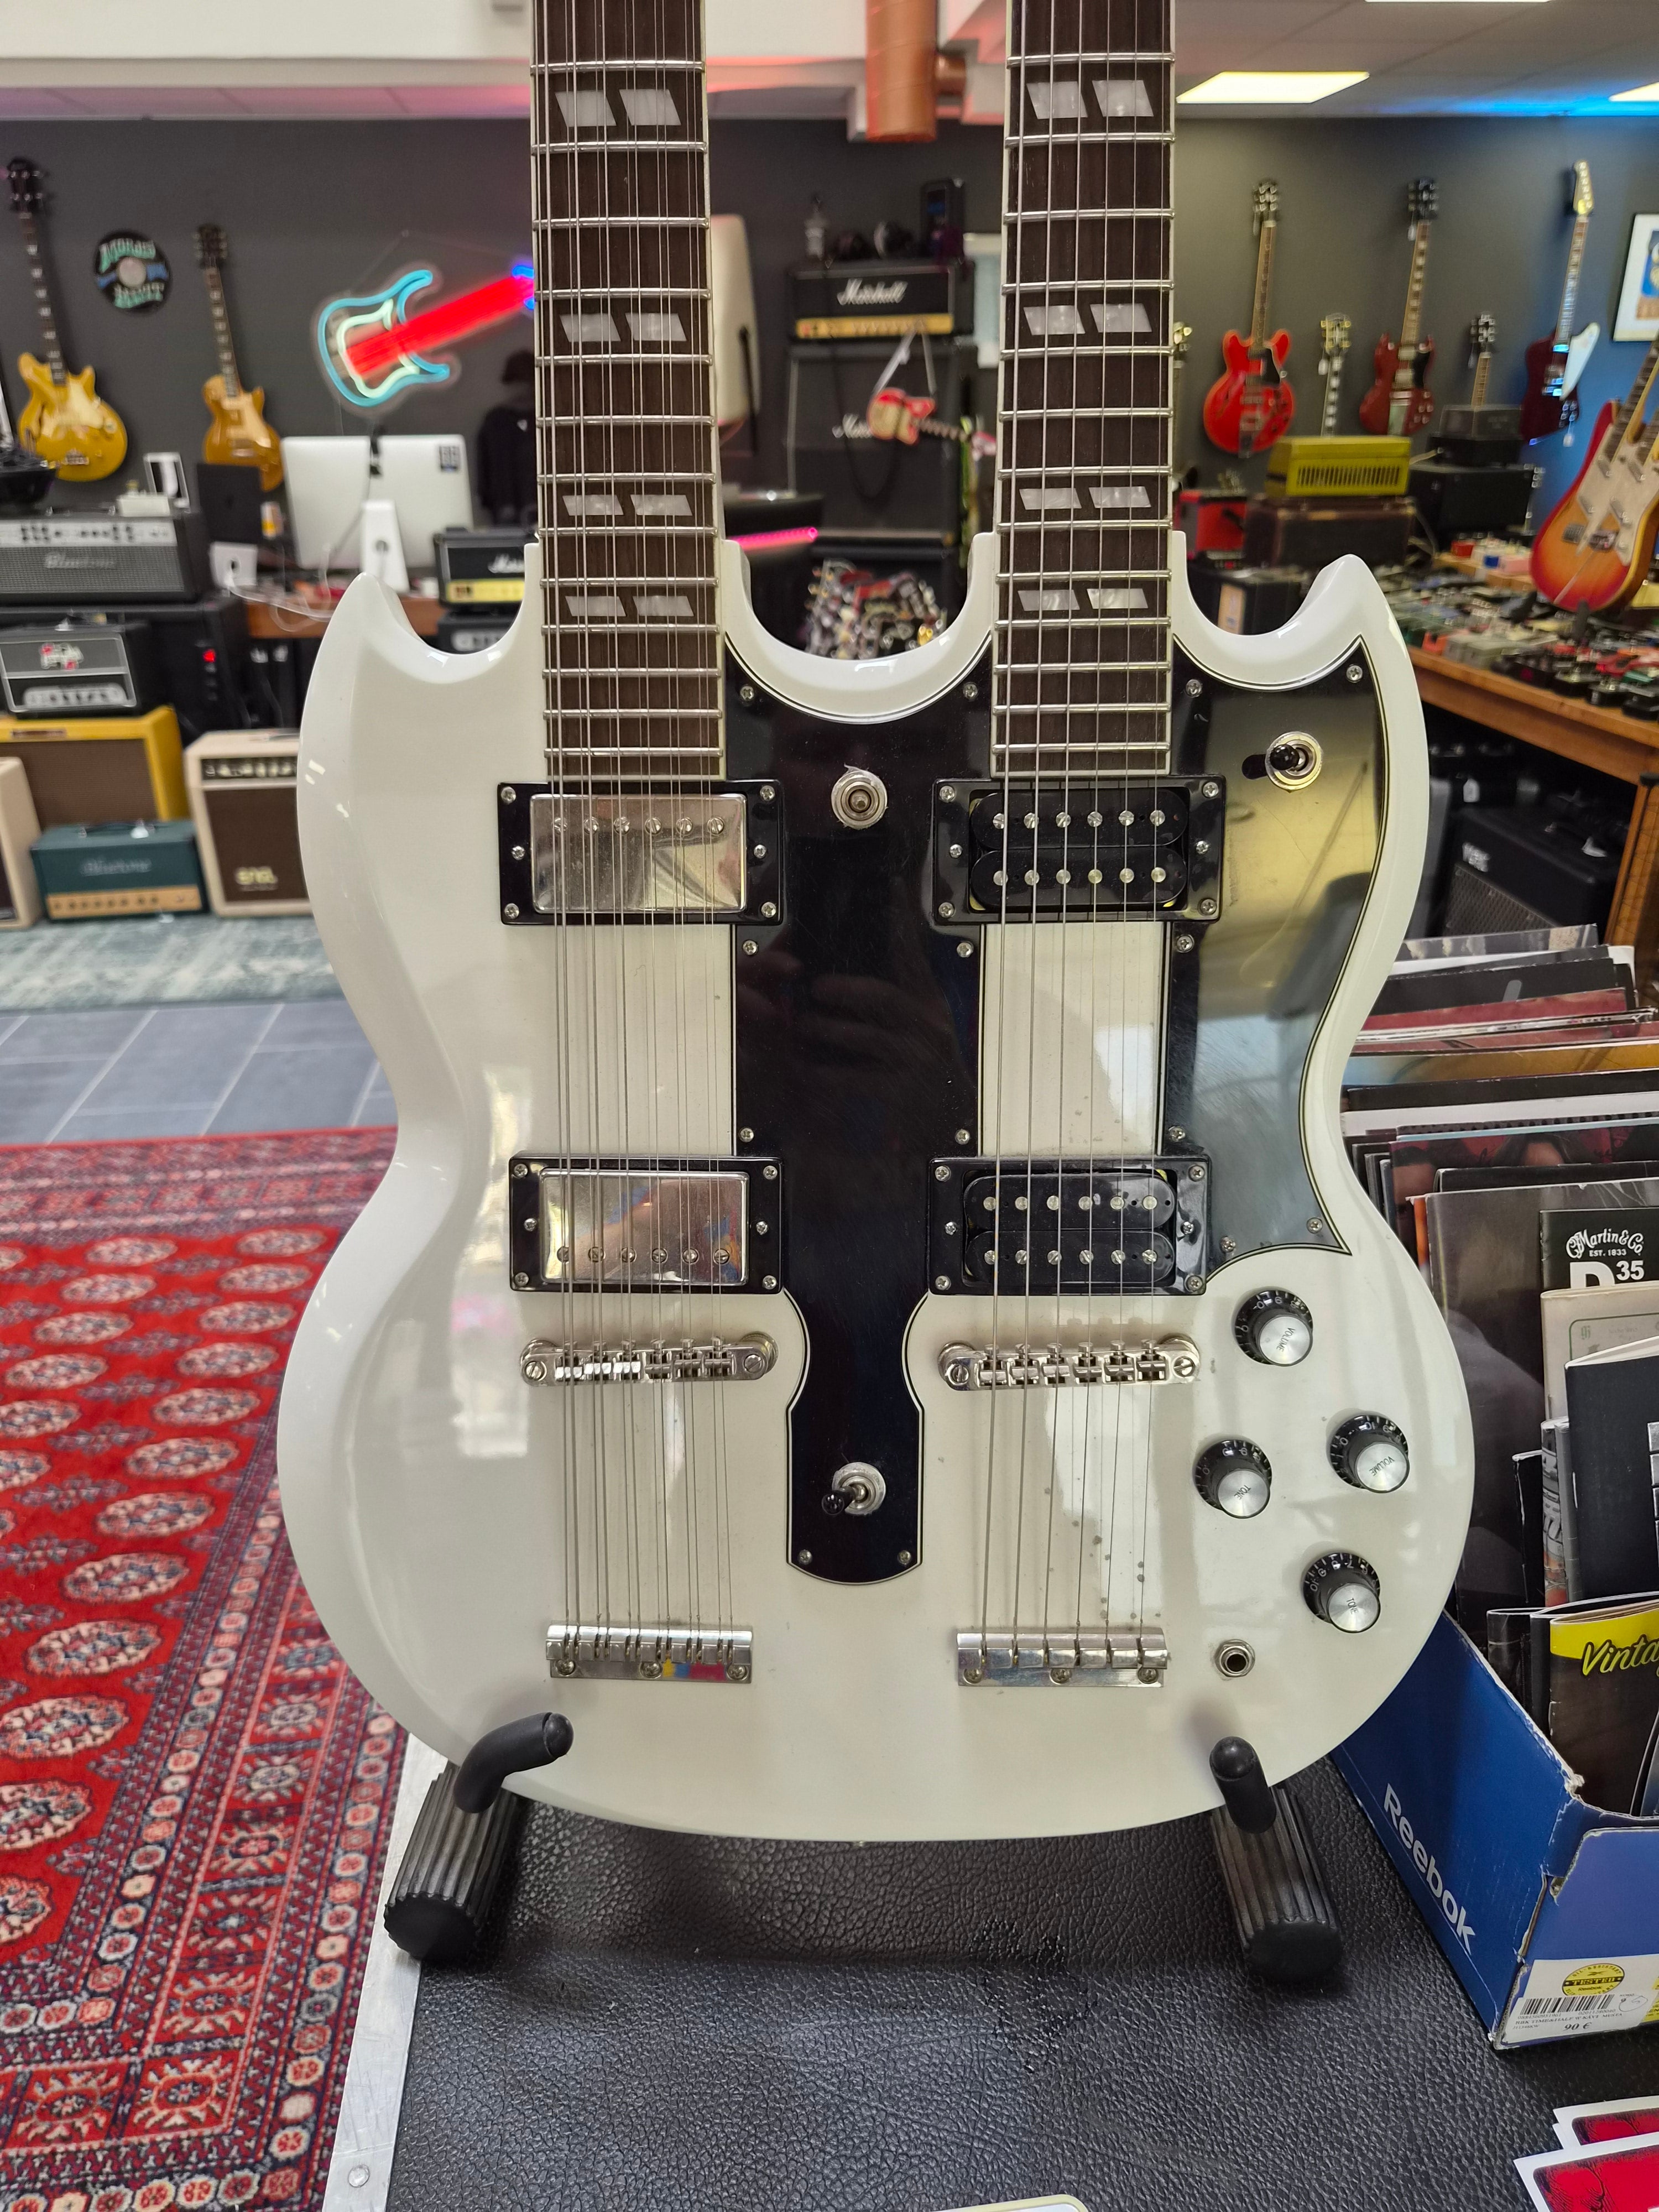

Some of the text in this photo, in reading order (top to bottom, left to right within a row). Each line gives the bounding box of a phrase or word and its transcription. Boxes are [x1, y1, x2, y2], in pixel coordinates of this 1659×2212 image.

[1616, 1260, 1645, 1281] 35
[1276, 1327, 1296, 1352] VOLUME
[1369, 1456, 1395, 1477] VOLUME
[1234, 1485, 1251, 1500] TONE
[1346, 1598, 1359, 1615] TONE
[1582, 1636, 1659, 1677] Vinta
[1384, 1783, 1476, 1956] Reebok
[1572, 1978, 1615, 1986] TESTED
[1563, 2023, 1579, 2031] 90
